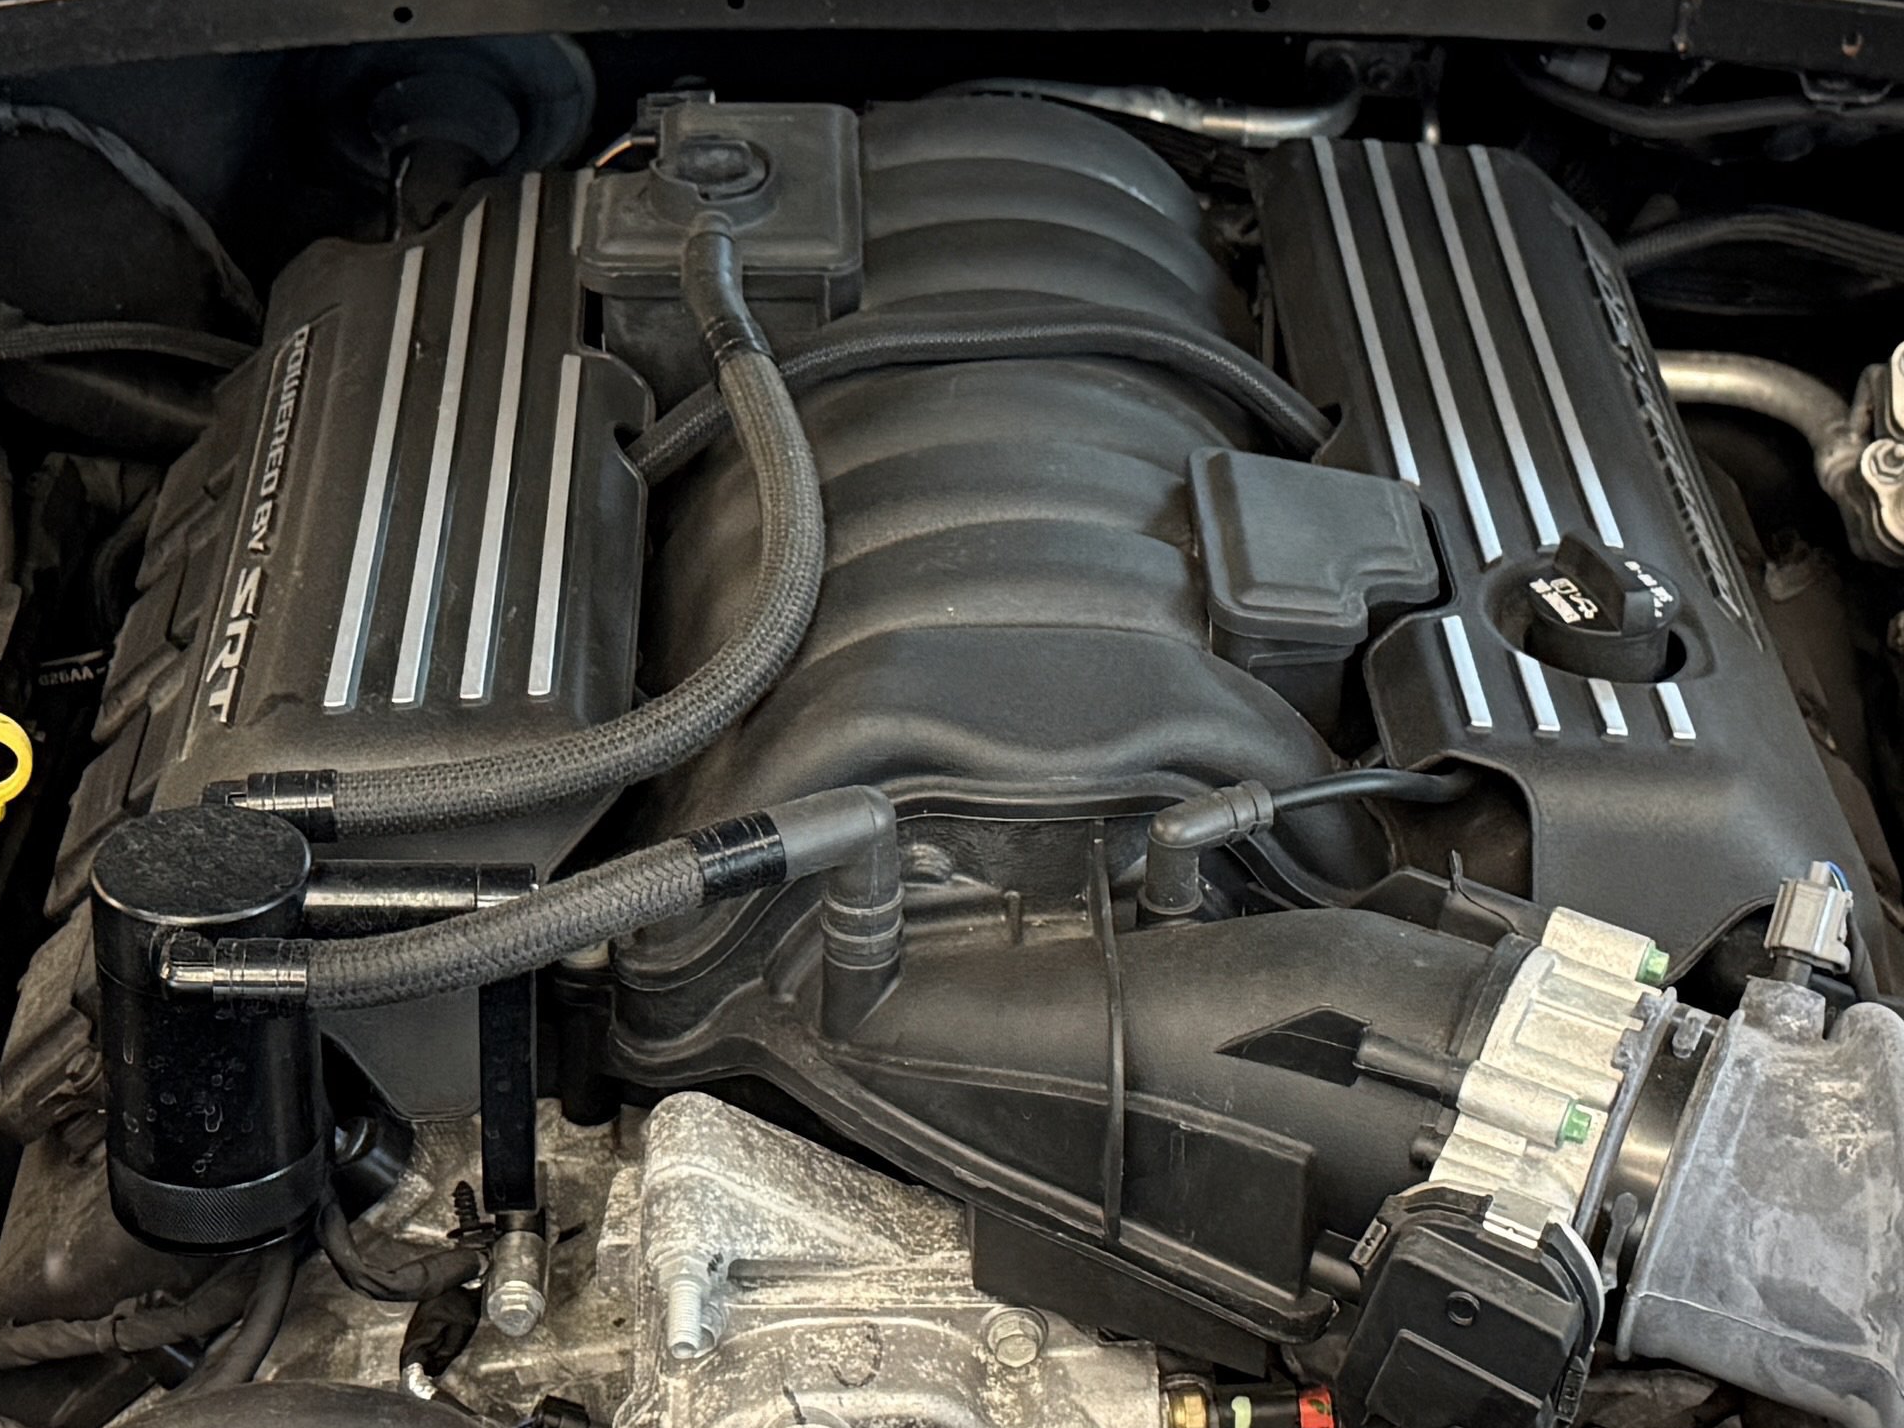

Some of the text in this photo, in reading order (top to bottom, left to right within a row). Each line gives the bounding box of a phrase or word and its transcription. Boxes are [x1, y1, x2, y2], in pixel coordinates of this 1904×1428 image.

[206, 324, 310, 723] POWERED BY SRT
